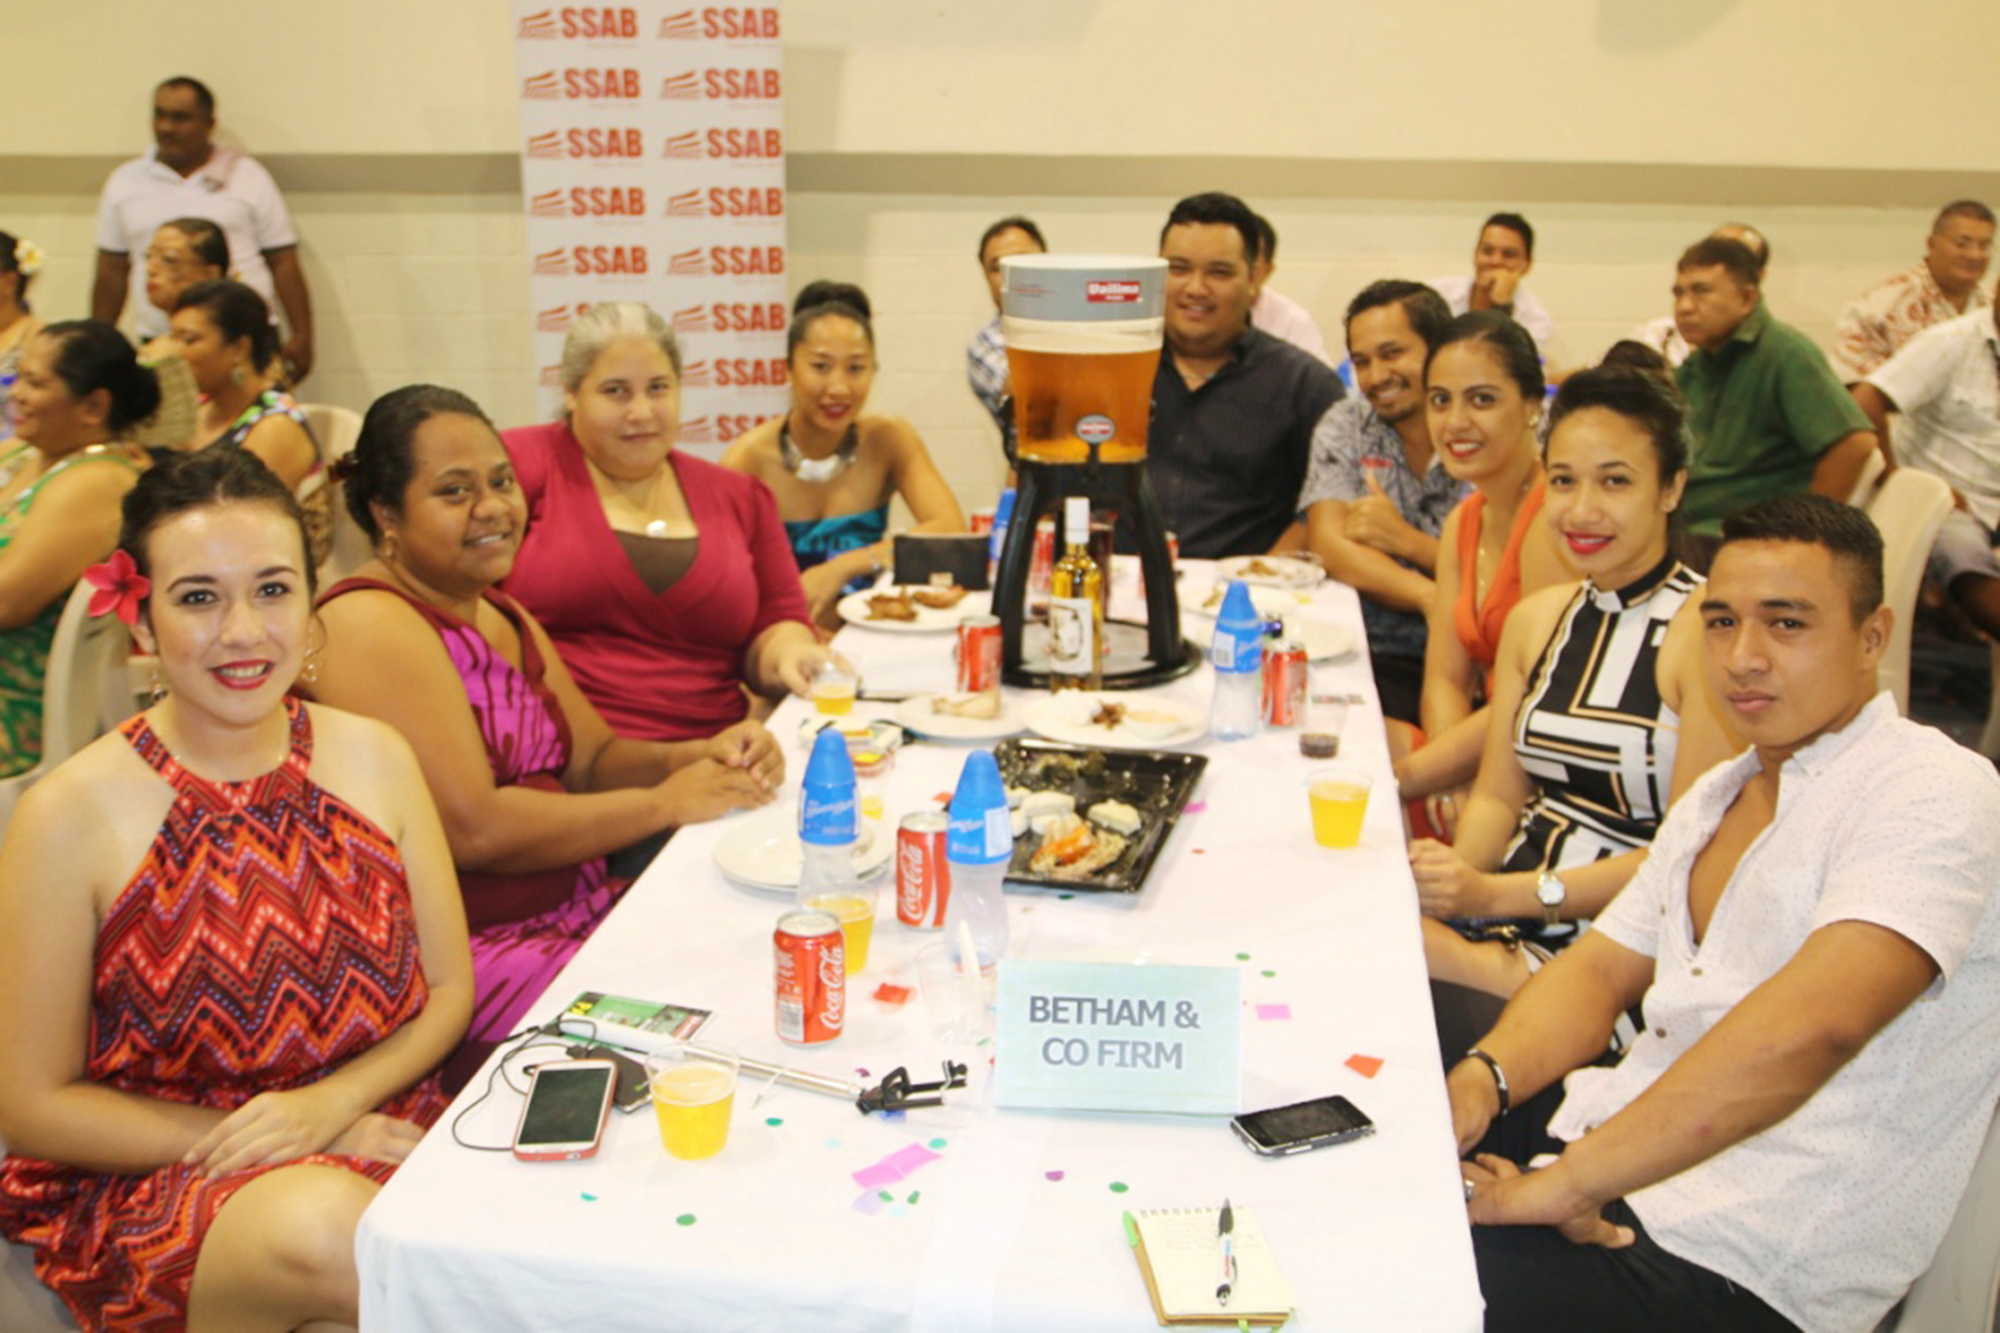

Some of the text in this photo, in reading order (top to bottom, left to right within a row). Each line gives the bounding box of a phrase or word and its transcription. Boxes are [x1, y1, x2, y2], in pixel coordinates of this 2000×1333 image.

[561, 7, 637, 39] SSAB
[703, 7, 779, 39] SSAB
[564, 69, 640, 99] SSAB
[705, 69, 780, 99] SSAB
[567, 128, 642, 158] SSAB
[707, 128, 782, 158] SSAB
[570, 187, 645, 217] SSAB
[709, 187, 783, 217] SSAB
[573, 246, 647, 275] SSAB
[710, 246, 784, 275] SSAB
[712, 303, 785, 332] SSAB
[715, 358, 788, 387] SSAB
[1029, 995, 1200, 1029] BETHAM &
[1042, 1036, 1183, 1070] CO FIRM
